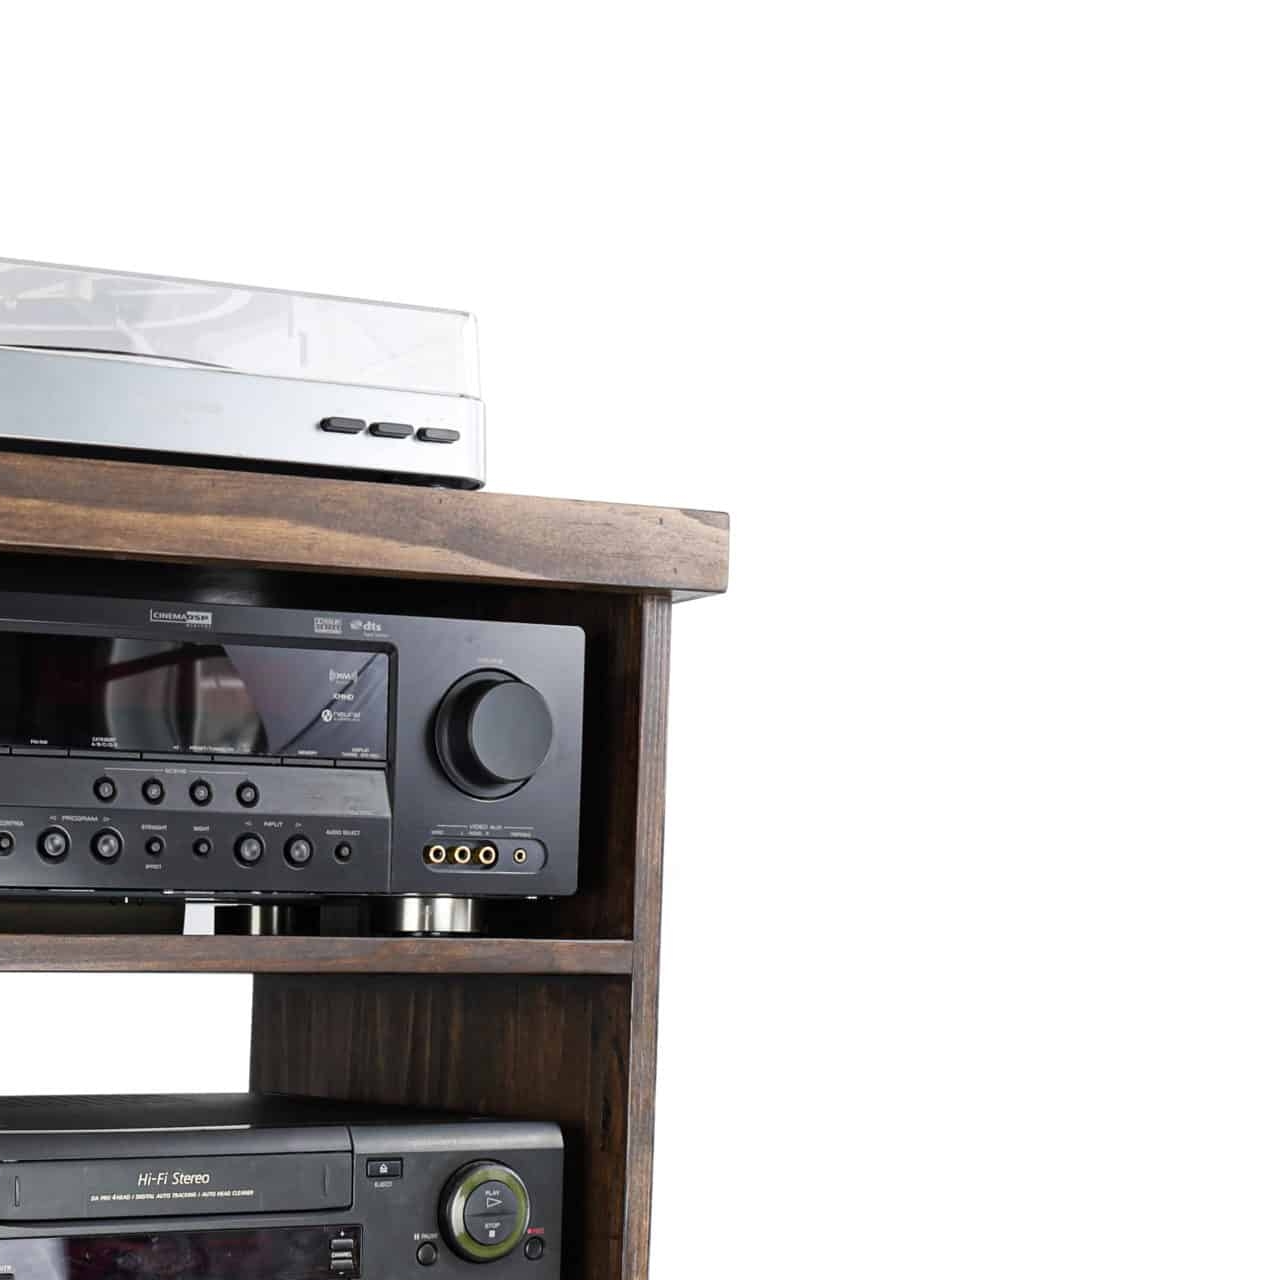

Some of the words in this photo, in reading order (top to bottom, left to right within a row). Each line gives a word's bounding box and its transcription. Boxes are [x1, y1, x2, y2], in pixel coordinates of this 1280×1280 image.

[363, 620, 383, 632] dts
[61, 815, 99, 823] PROGRAM
[263, 821, 284, 829] INPUT
[137, 1171, 169, 1187] Hi-Fi
[171, 1171, 210, 1186] Stereo
[172, 1191, 197, 1199] TRACKING
[485, 1189, 501, 1197] PLAY
[484, 1222, 501, 1230] STOP
